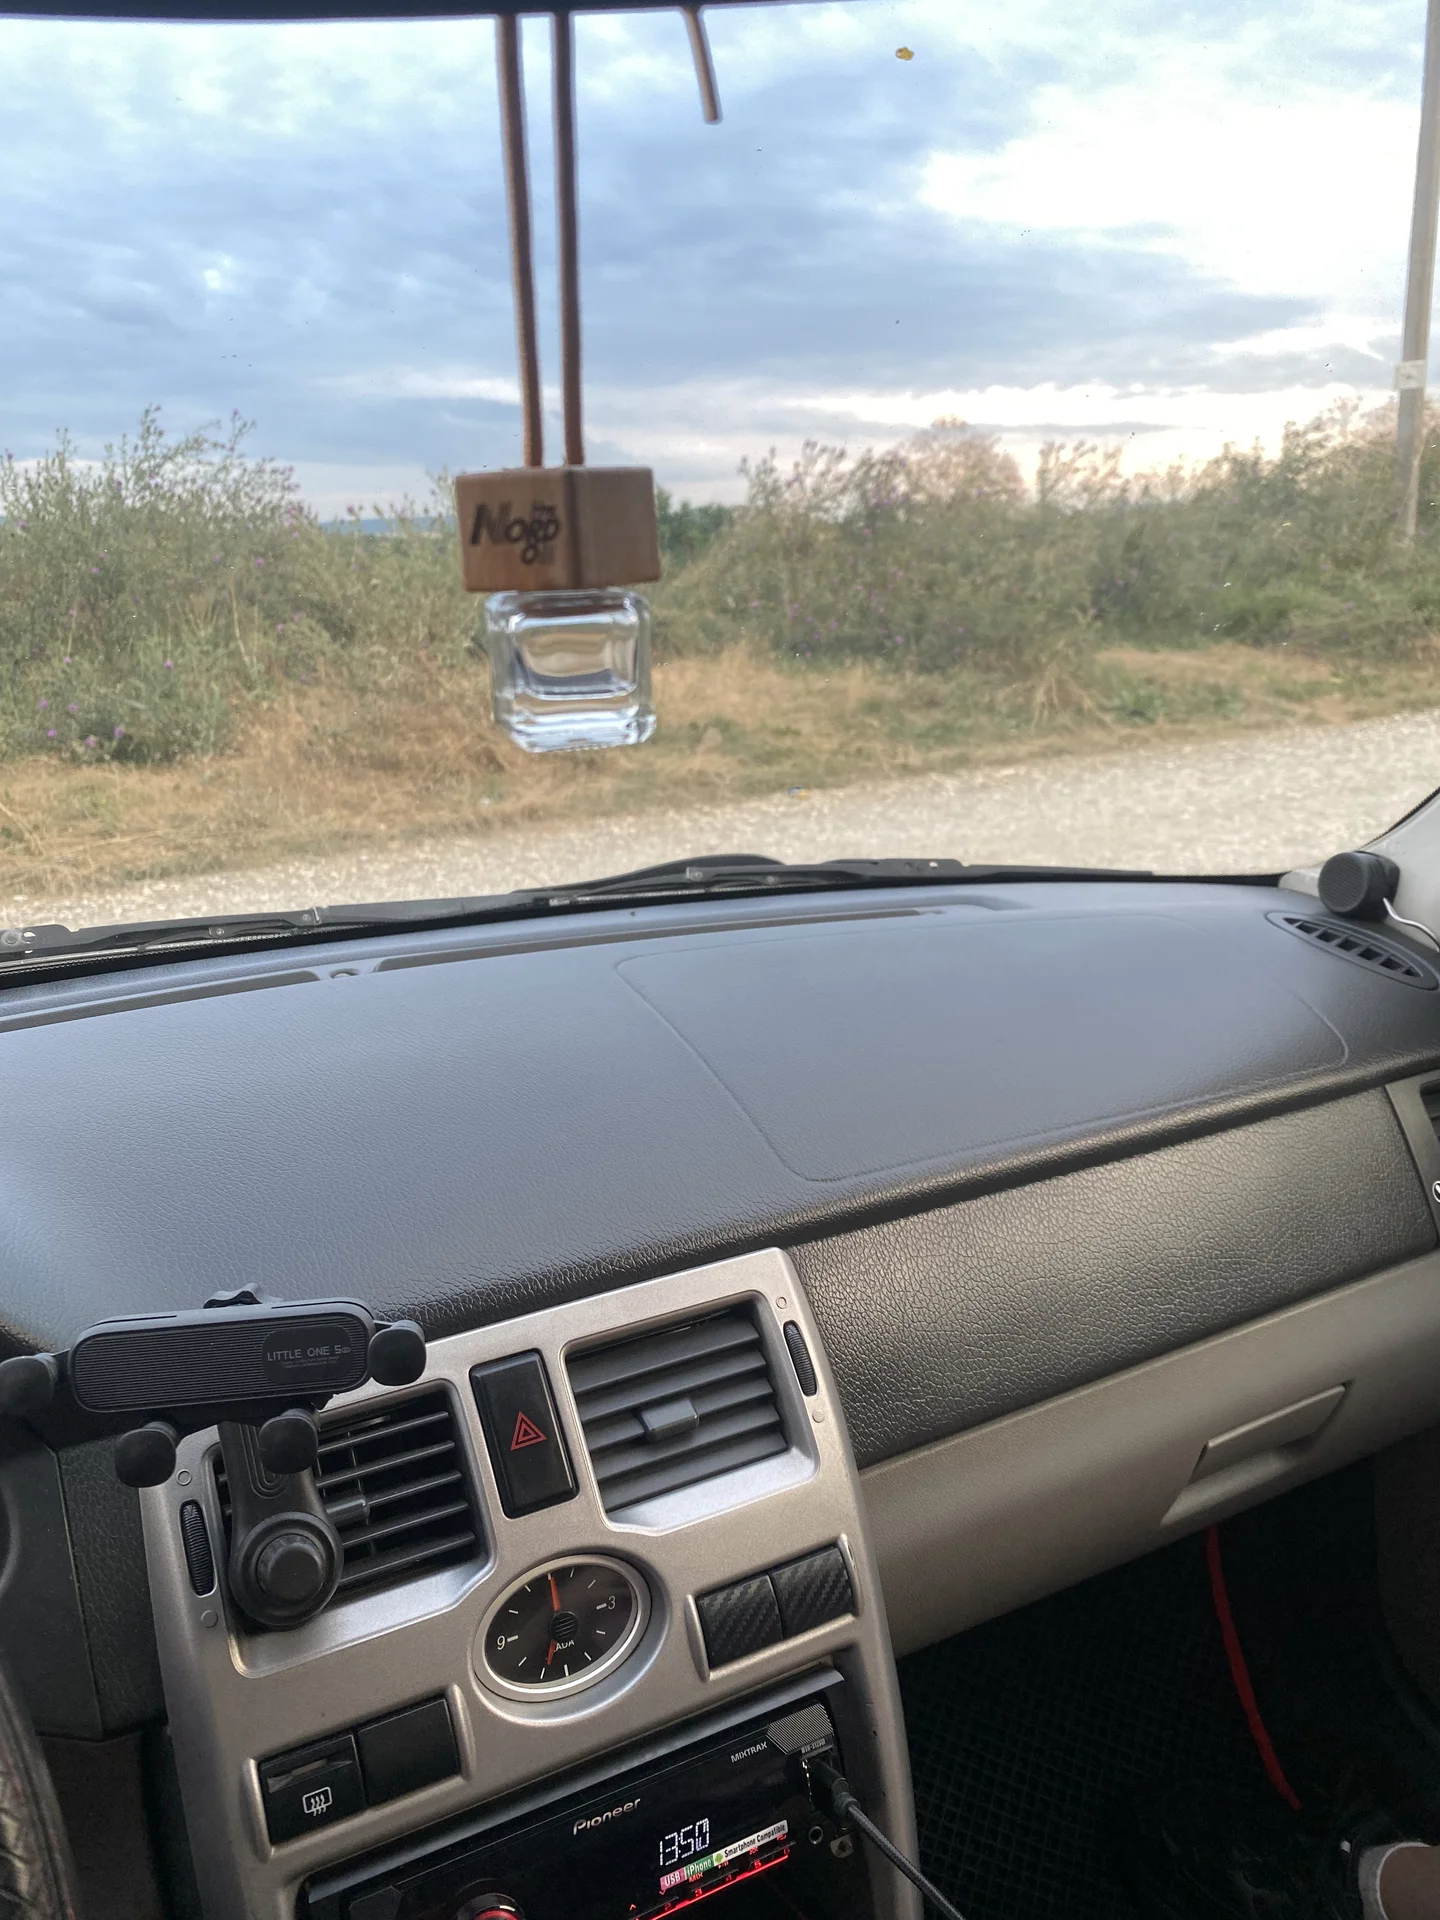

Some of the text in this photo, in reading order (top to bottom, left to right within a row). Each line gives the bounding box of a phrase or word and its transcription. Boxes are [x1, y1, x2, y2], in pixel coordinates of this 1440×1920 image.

[267, 1349, 302, 1361] LITTLE
[307, 1346, 330, 1357] ONE
[608, 1595, 616, 1610] 3
[497, 1635, 506, 1650] 9
[730, 1741, 768, 1762] MIXTRAX
[573, 1798, 641, 1836] Pioneer
[664, 1823, 786, 1887] USB iPhone Smartphone Compatible
